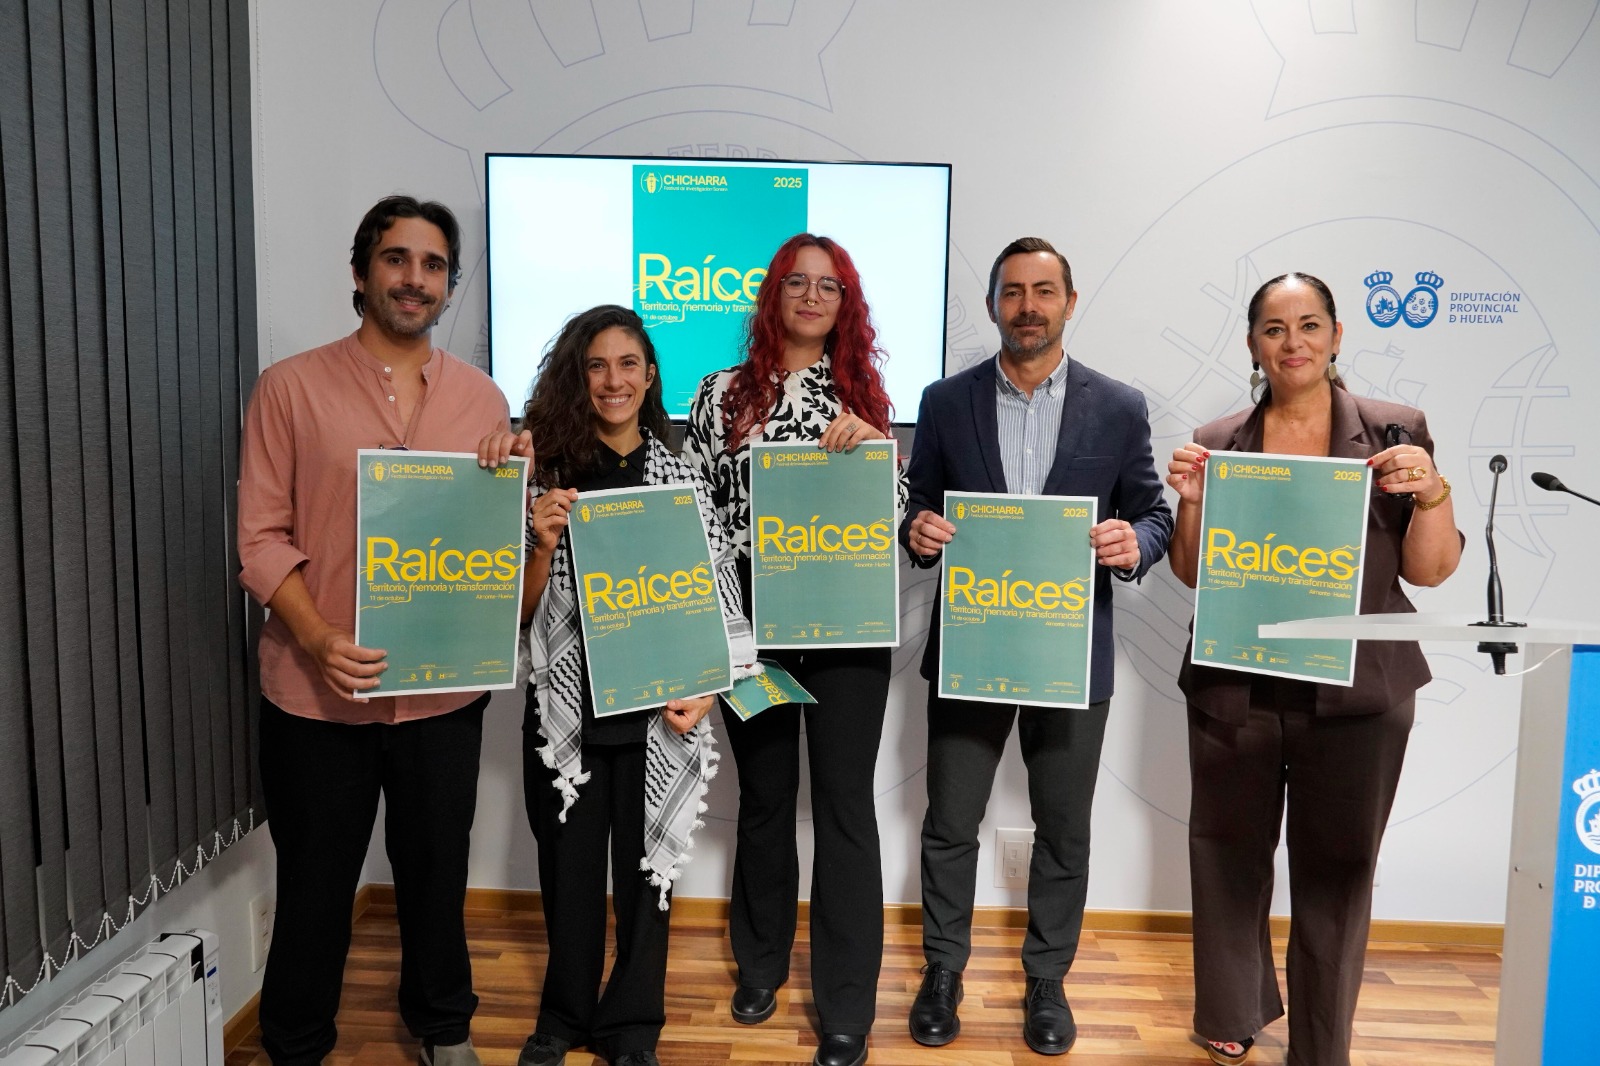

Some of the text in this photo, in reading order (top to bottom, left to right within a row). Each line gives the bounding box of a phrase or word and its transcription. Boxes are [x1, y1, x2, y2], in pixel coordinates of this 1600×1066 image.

[663, 174, 728, 186] CHICHARRA
[773, 177, 802, 189] 2025
[638, 253, 767, 301] Raíce
[1450, 291, 1520, 302] DIPUTACIÓN
[640, 301, 681, 312] Territorio,
[685, 303, 723, 312] memoria
[725, 305, 730, 314] y
[1450, 304, 1518, 313] PROVINCIAL
[1460, 314, 1503, 324] HUELVA
[776, 452, 828, 462] CHICHARRA
[865, 451, 889, 460] 2025
[391, 463, 454, 475] CHICHARRA
[495, 468, 519, 479] 2025
[1233, 464, 1291, 476] CHICHARRA
[1333, 470, 1362, 481] 2025
[673, 495, 693, 505] 2025
[595, 500, 644, 513] CHICHARRA
[970, 504, 1024, 515] CHICHARRA
[1063, 507, 1088, 518] 2025
[758, 515, 891, 554] Raíces
[366, 537, 517, 582] Raíces
[760, 552, 891, 563] Territorio, memoria y transformación
[1206, 528, 1355, 581] Raíces
[1206, 567, 1352, 590] Territorio, memoria y transformación
[367, 582, 515, 593] Territorio, memoria y transformación
[583, 565, 713, 614] Raíces
[948, 566, 1085, 611] Raíces
[590, 613, 626, 623] Territorio,
[627, 606, 659, 618] memoria
[666, 596, 715, 611] transformación
[949, 605, 982, 615] Territorio,
[985, 608, 1017, 617] memoria
[1026, 609, 1084, 620] transformación
